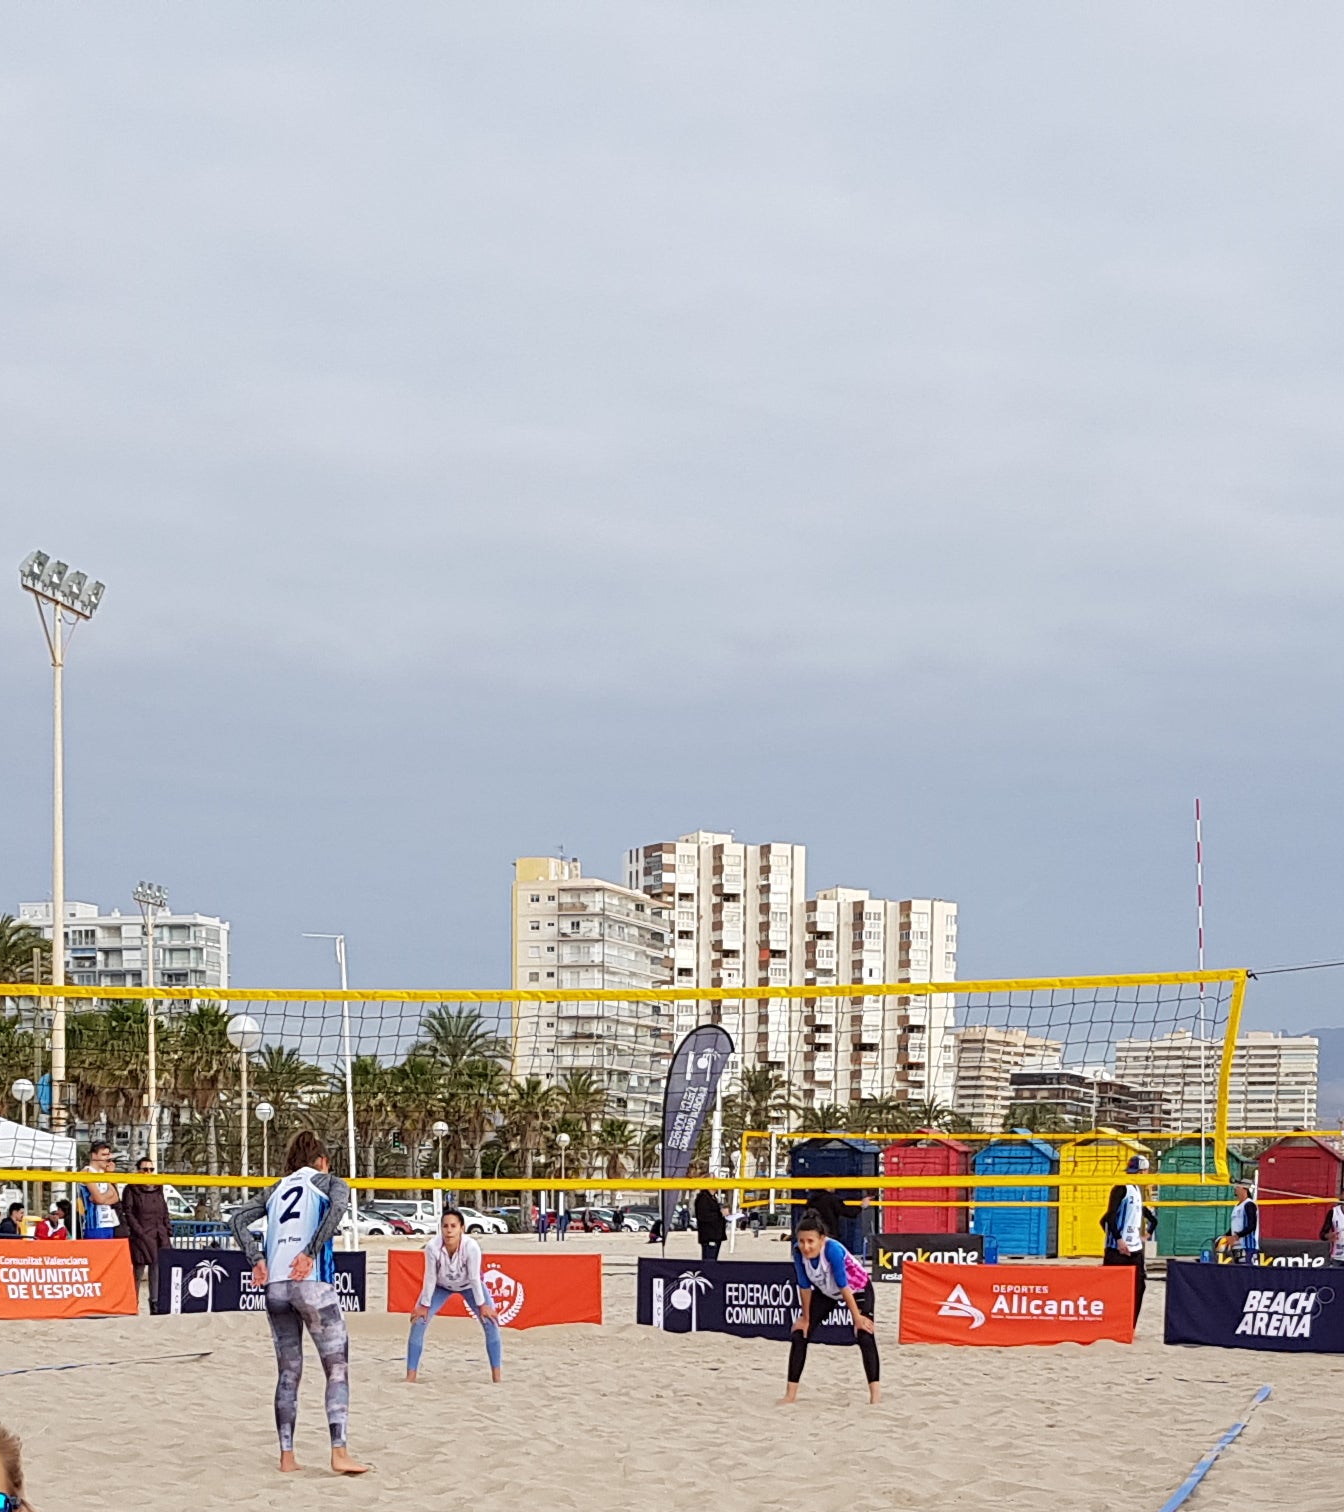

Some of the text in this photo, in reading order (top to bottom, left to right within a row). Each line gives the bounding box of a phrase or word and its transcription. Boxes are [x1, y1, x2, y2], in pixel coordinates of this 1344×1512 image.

[279, 1186, 304, 1225] 2
[0, 1256, 89, 1266] Comunitat Valenciana
[878, 1248, 979, 1270] krokante
[0, 1267, 90, 1284] COMUNITAT
[7, 1282, 102, 1299] DE L'ESPORT
[725, 1280, 794, 1305] FEDERACIÓ
[992, 1284, 1049, 1294] DEPORTES
[990, 1294, 1105, 1316] Alicante
[1243, 1290, 1317, 1314] BEACH
[725, 1307, 786, 1325] COMUNITAT
[1235, 1314, 1312, 1338] ARENA
